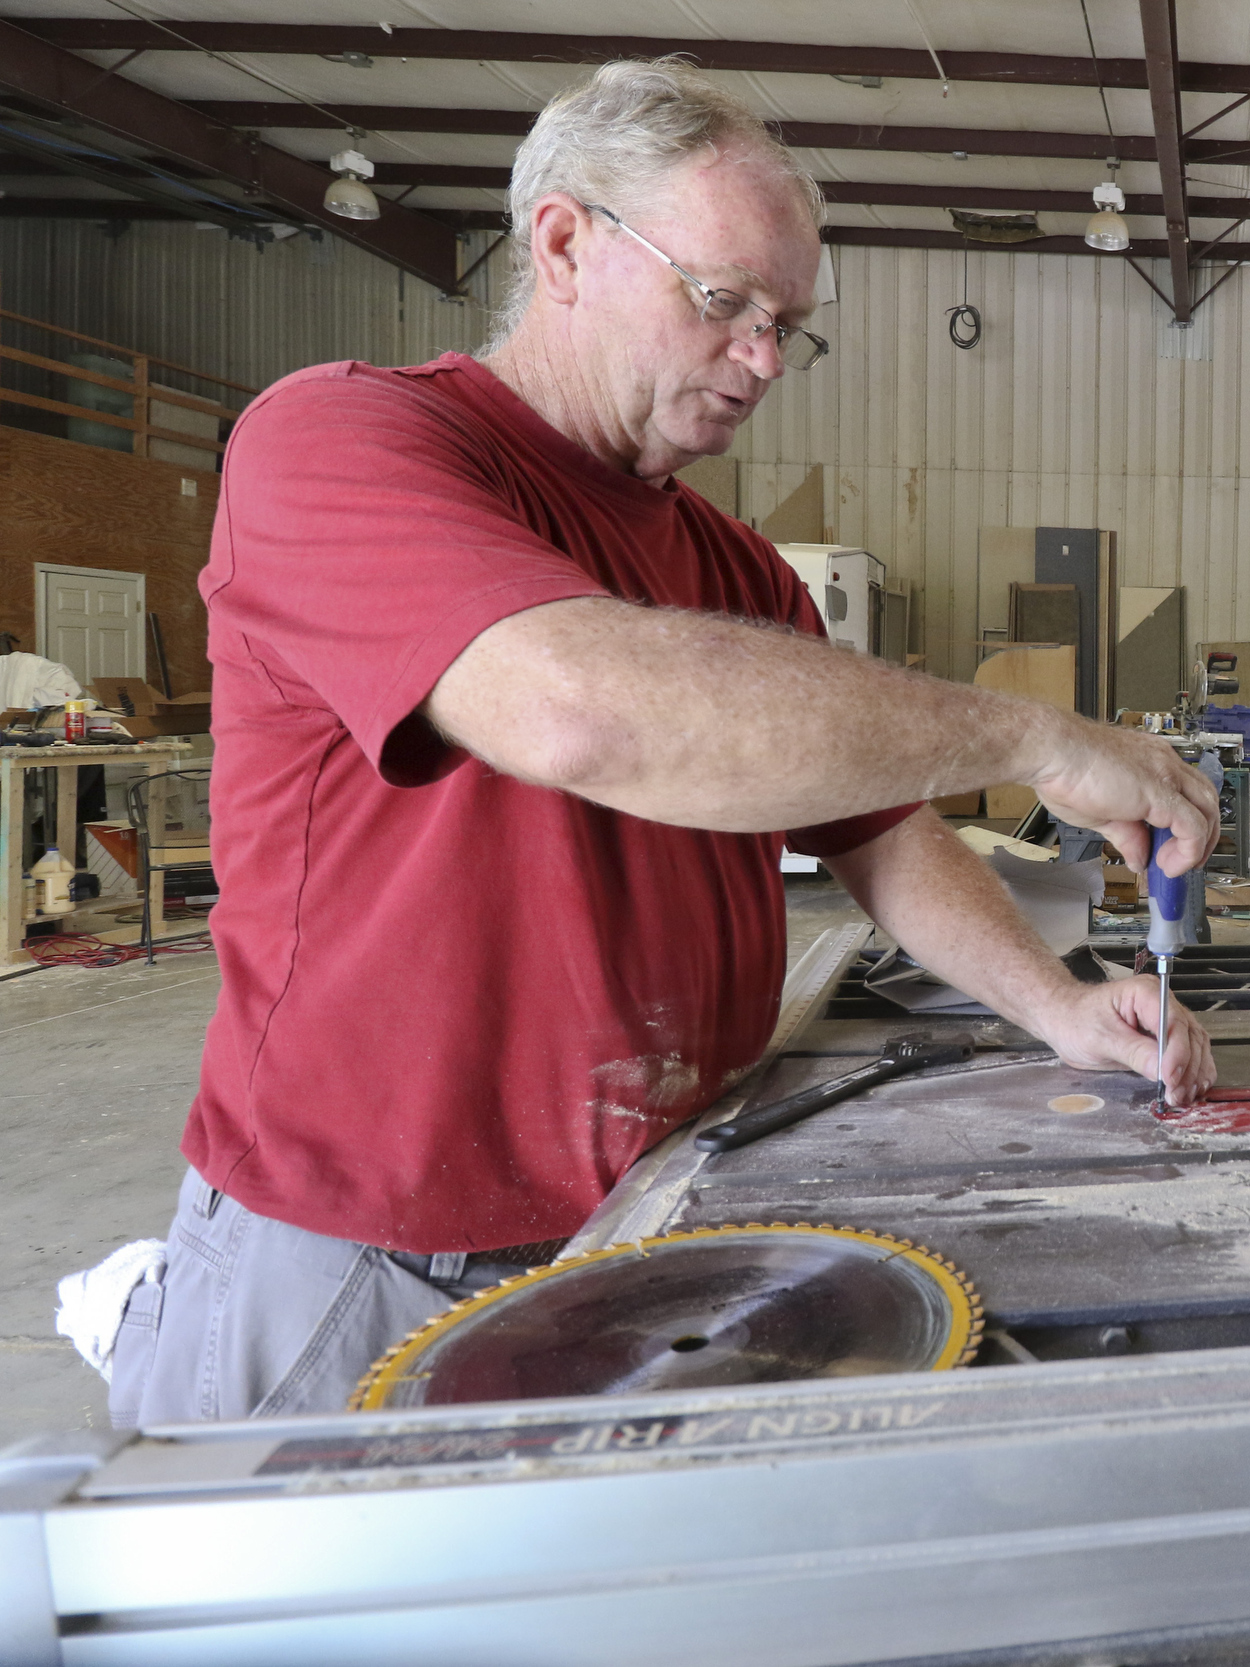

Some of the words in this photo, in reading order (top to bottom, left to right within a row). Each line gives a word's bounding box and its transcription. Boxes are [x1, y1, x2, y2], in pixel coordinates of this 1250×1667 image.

[678, 1416, 736, 1445] A
[746, 1400, 944, 1440] ALIGN
[551, 1421, 665, 1454] RIP
